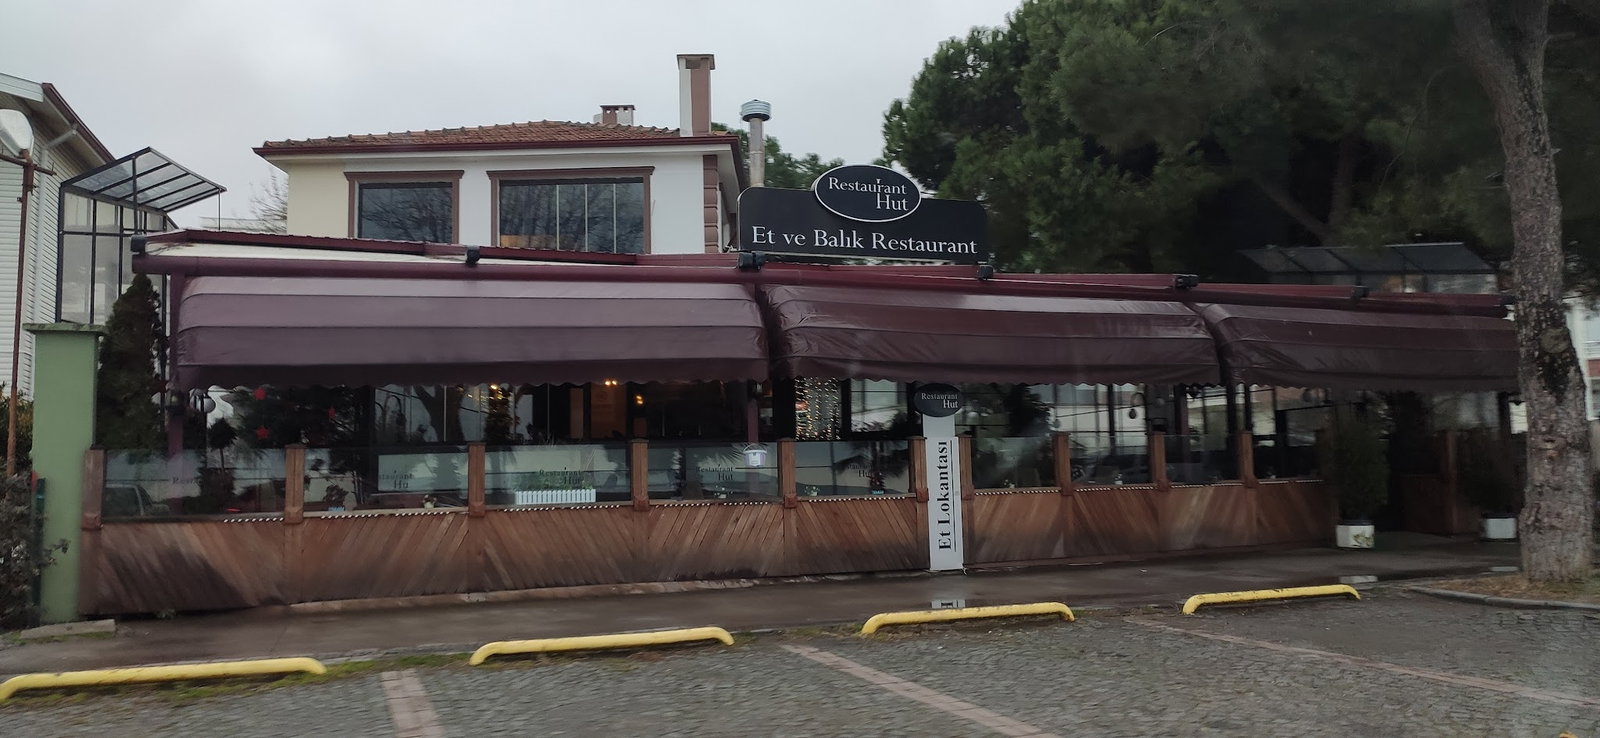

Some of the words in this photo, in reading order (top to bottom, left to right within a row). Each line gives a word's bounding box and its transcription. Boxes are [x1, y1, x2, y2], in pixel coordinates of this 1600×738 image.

[829, 177, 907, 195] Restaurant
[876, 193, 909, 211] Hut
[752, 226, 775, 245] Et
[782, 233, 806, 246] ve
[814, 229, 864, 249] Balık
[872, 233, 978, 254] Restaurant
[921, 392, 958, 401] Restaurant
[943, 399, 958, 409] Hut
[937, 441, 950, 527] Lokantası
[938, 531, 951, 550] Et
